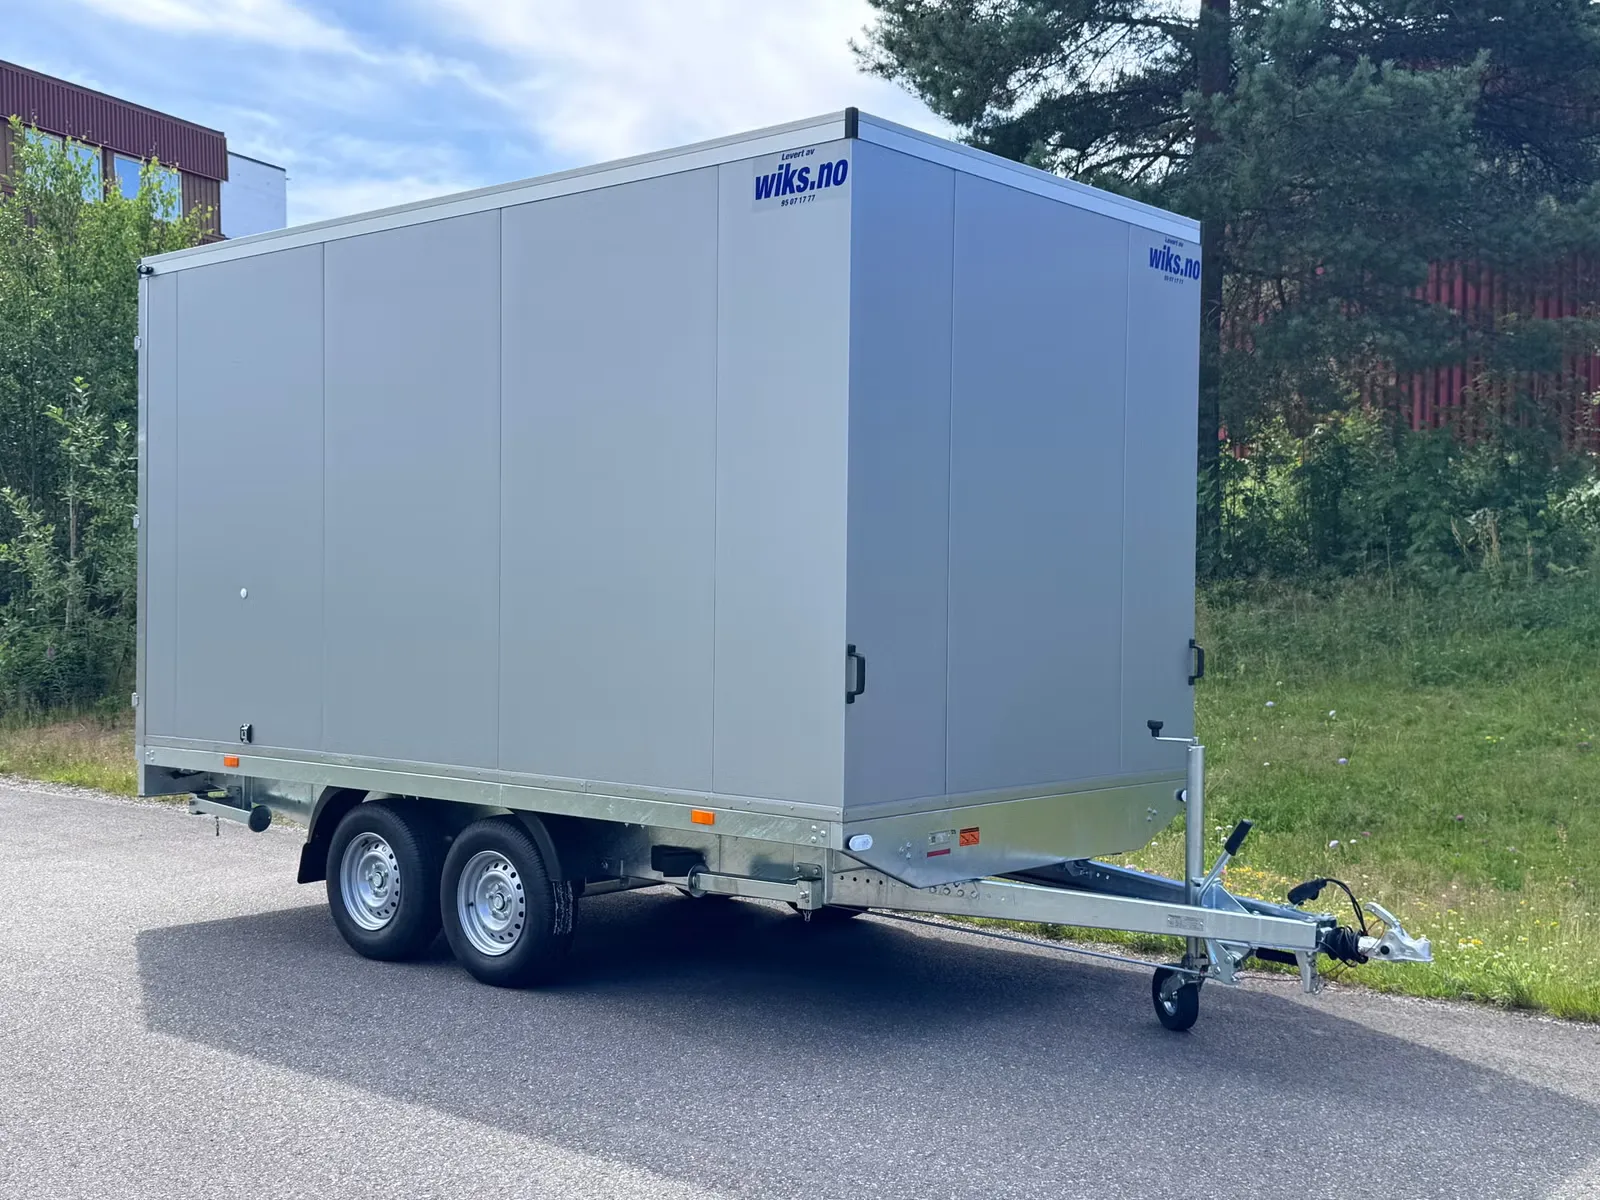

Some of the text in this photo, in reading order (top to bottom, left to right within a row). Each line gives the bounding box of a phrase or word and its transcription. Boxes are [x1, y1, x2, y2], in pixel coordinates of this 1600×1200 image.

[781, 148, 816, 161] Levert av
[755, 159, 848, 200] wiks.no
[781, 194, 816, 207] 95 07 17 77
[1149, 244, 1200, 280] wiks.no
